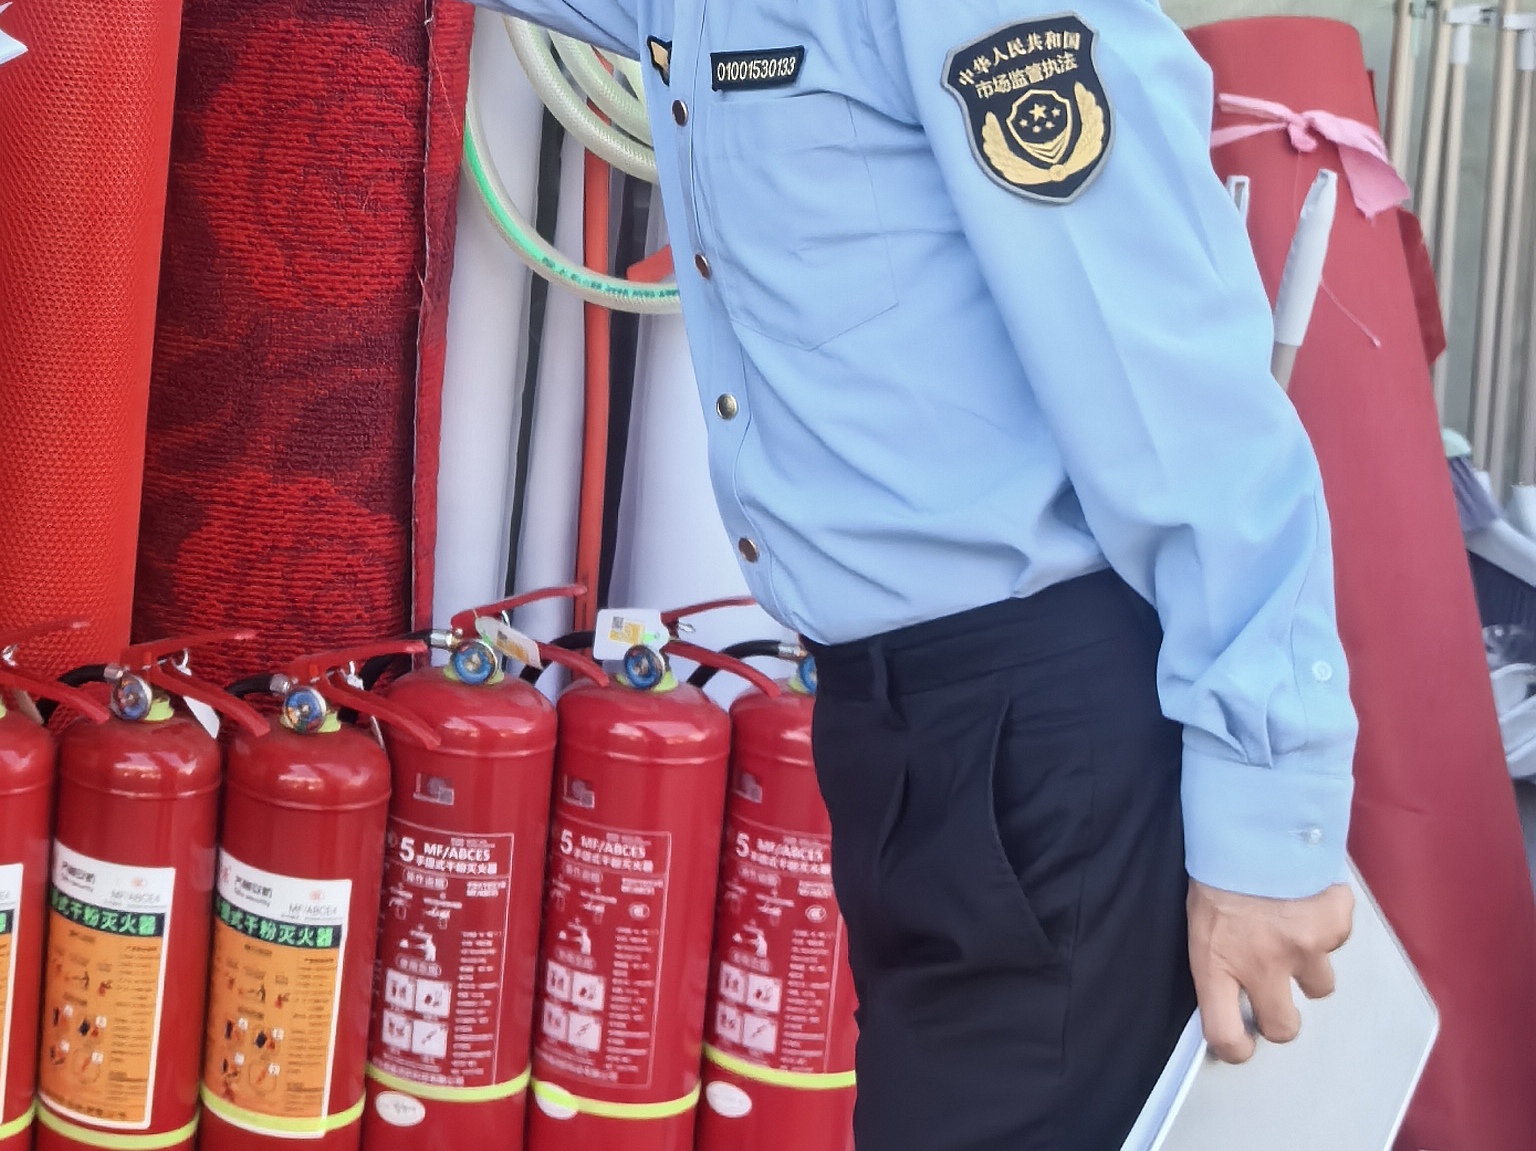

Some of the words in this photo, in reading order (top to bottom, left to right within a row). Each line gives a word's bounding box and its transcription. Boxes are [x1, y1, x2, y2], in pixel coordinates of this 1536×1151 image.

[716, 56, 797, 83] 01001530133
[957, 29, 1081, 86] 中华人民共和国
[974, 53, 1077, 100] 市场监管执法
[398, 836, 416, 863] 5
[560, 828, 574, 856] 5
[735, 831, 751, 859] 5
